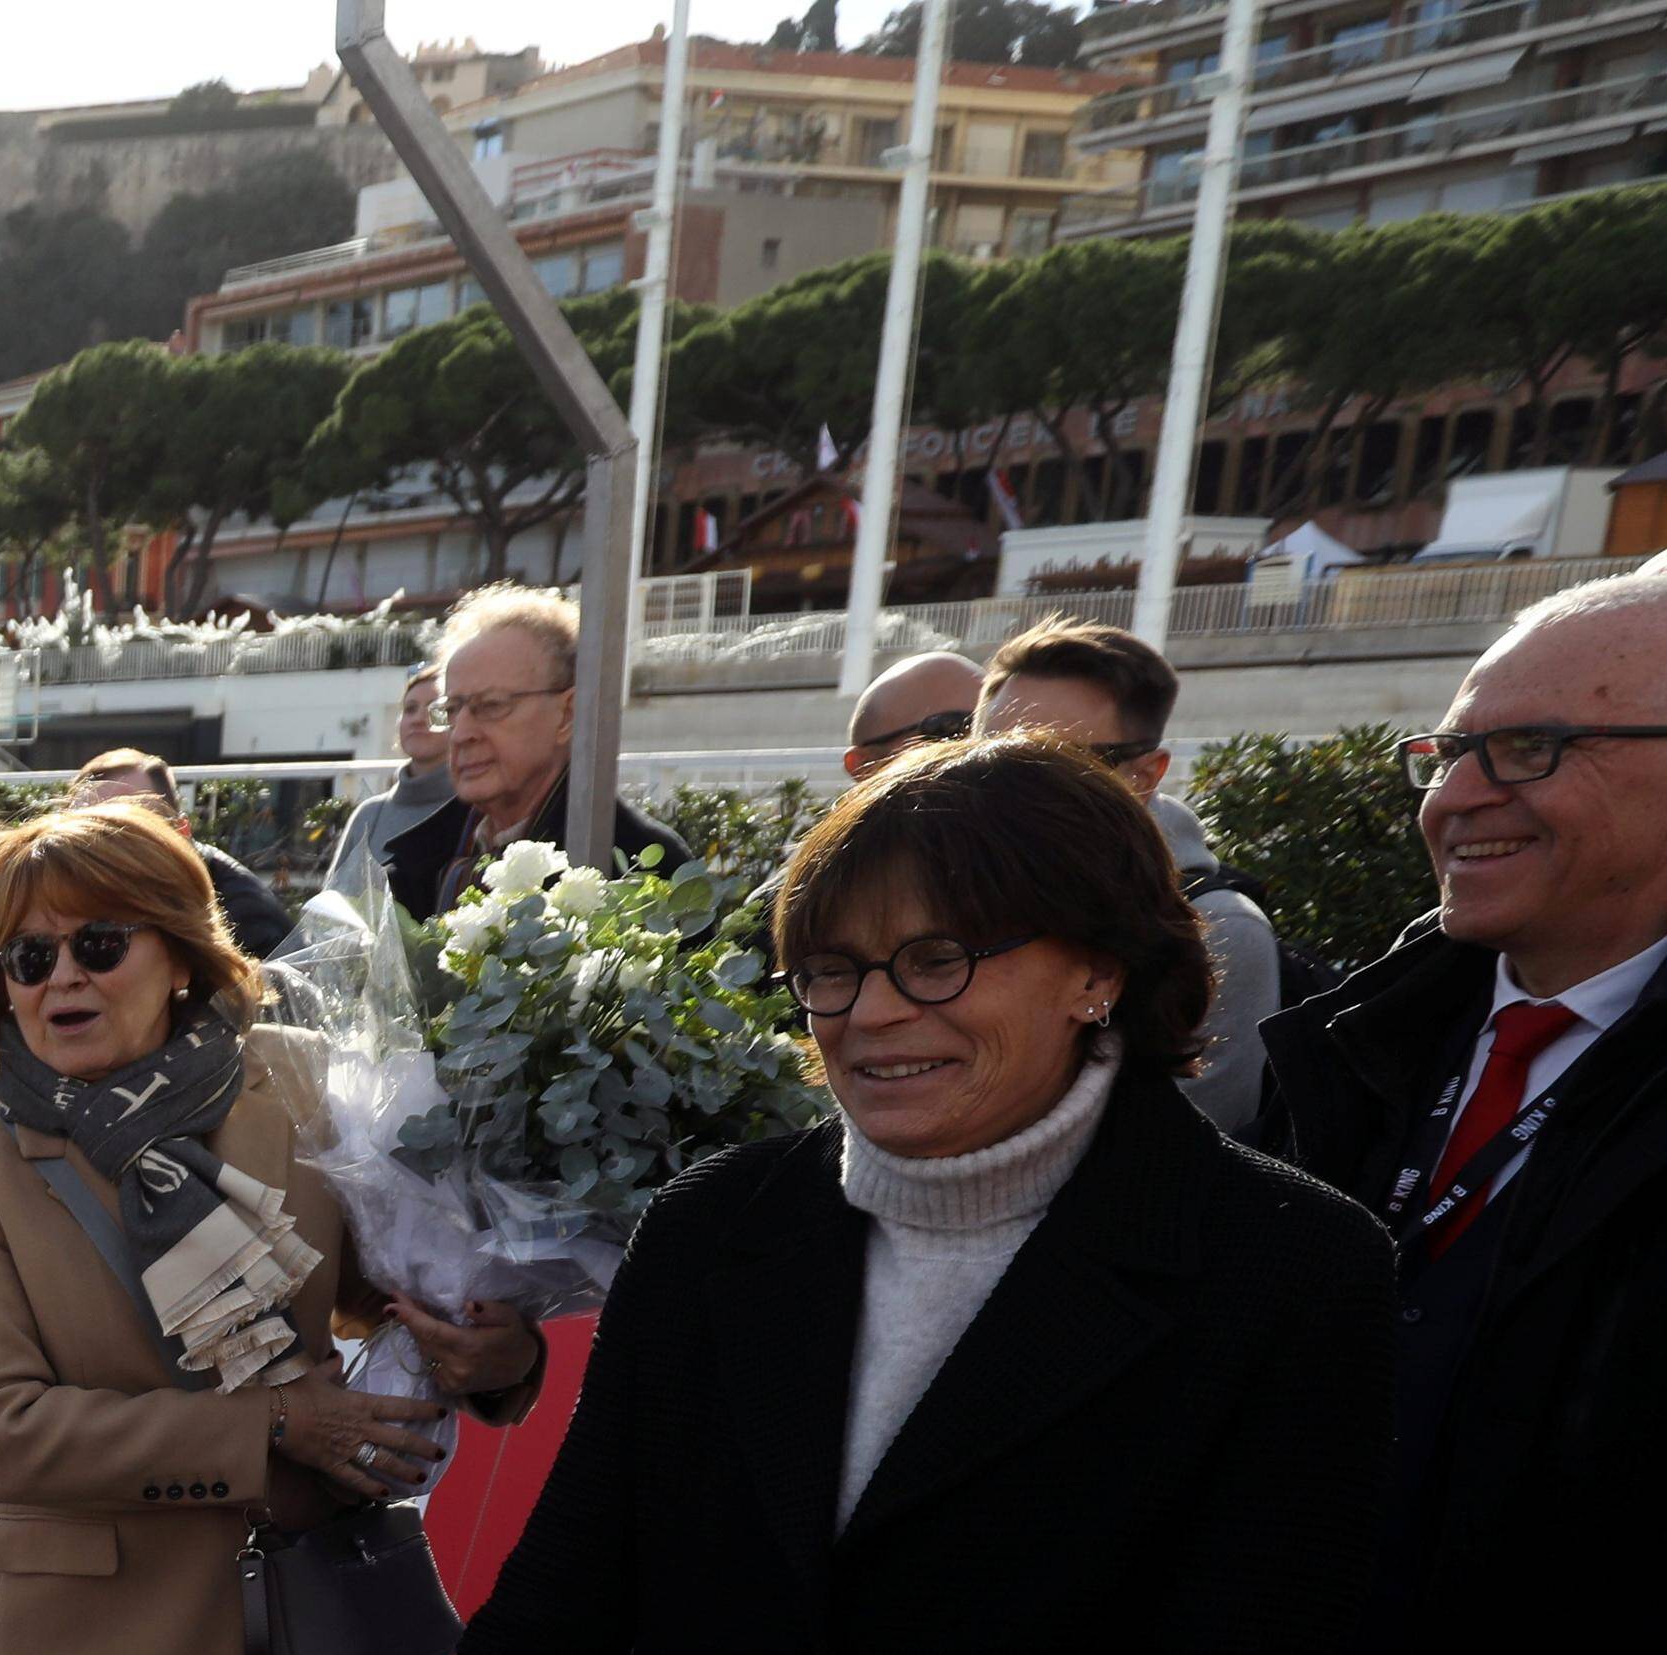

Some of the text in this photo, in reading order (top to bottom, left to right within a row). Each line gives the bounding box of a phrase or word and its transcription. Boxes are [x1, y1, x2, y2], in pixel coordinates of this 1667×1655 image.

[1431, 1106, 1448, 1117] B
[1511, 1108, 1549, 1142] KING
[1388, 1167, 1422, 1213] B KING
[1422, 1184, 1468, 1226] B KING
